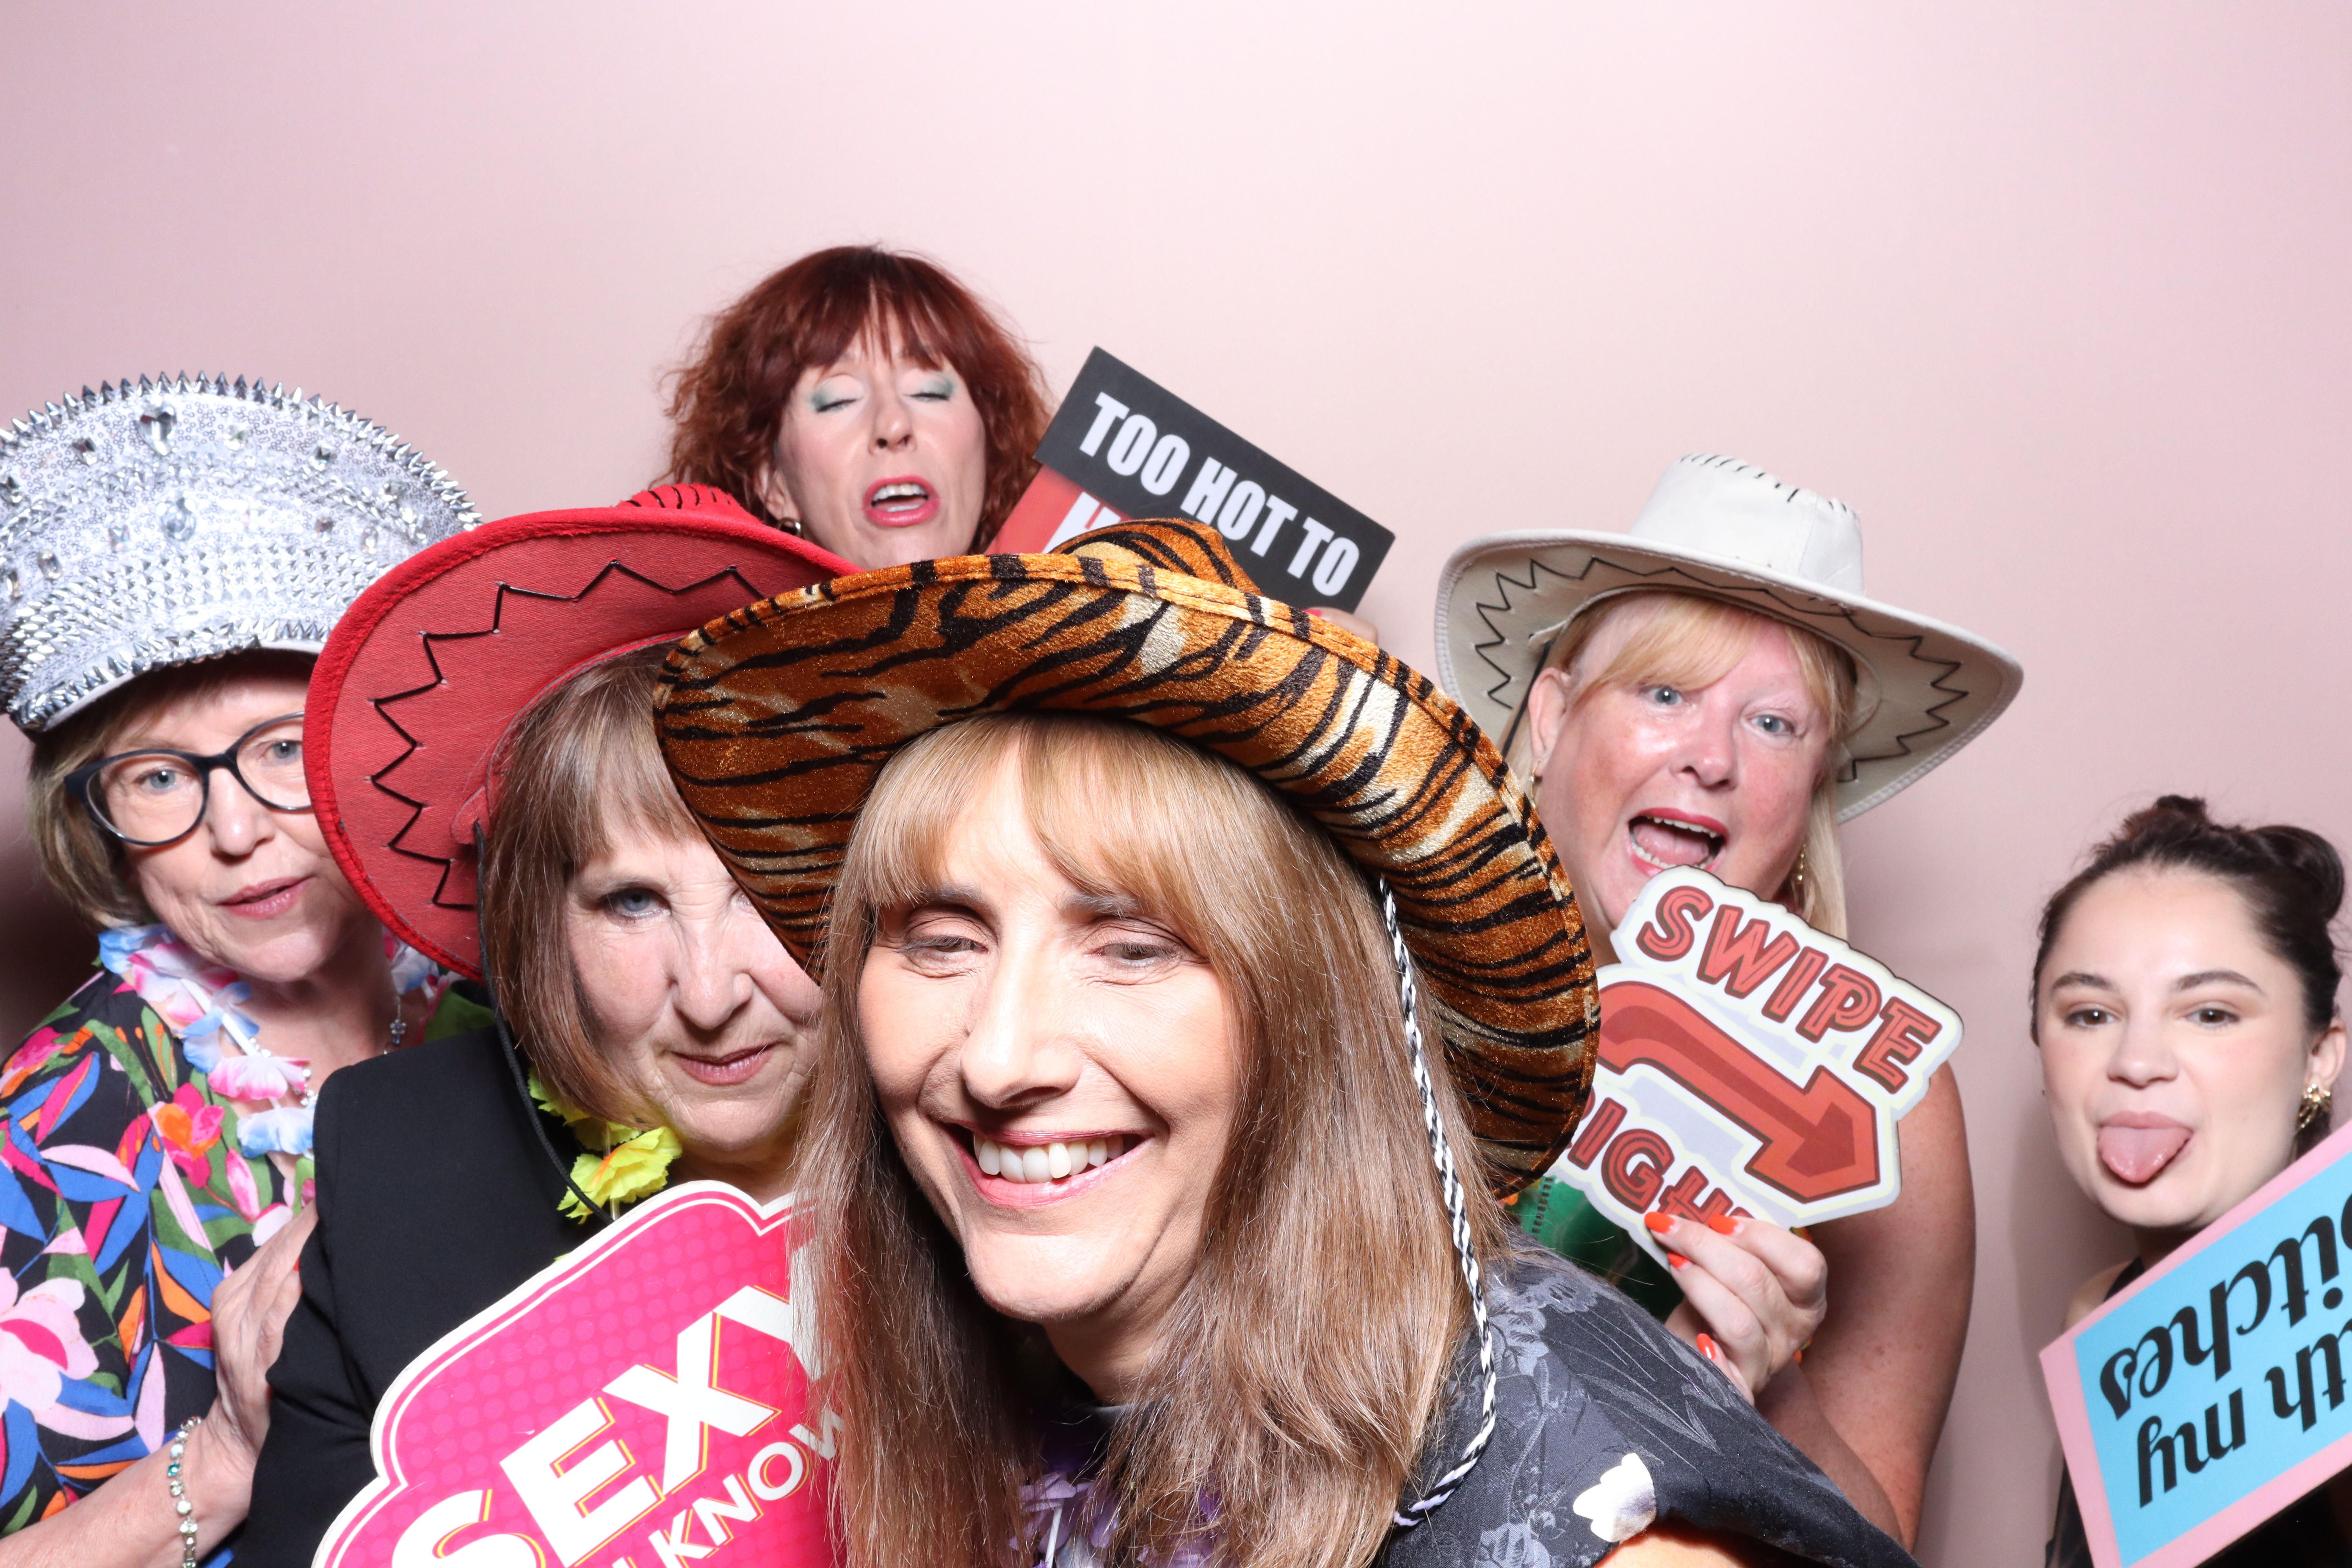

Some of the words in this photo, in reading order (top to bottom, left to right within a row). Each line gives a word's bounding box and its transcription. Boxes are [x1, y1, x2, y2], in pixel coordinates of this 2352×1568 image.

[1079, 392, 1191, 495] TOO
[1180, 456, 1298, 557] HOT
[1287, 517, 1359, 596] TO
[1636, 886, 1942, 1094] SWIPE
[1566, 1085, 1755, 1225] IGH
[2100, 1193, 2352, 1421] itches
[2265, 1318, 2352, 1433] th
[2137, 1387, 2246, 1508] my
